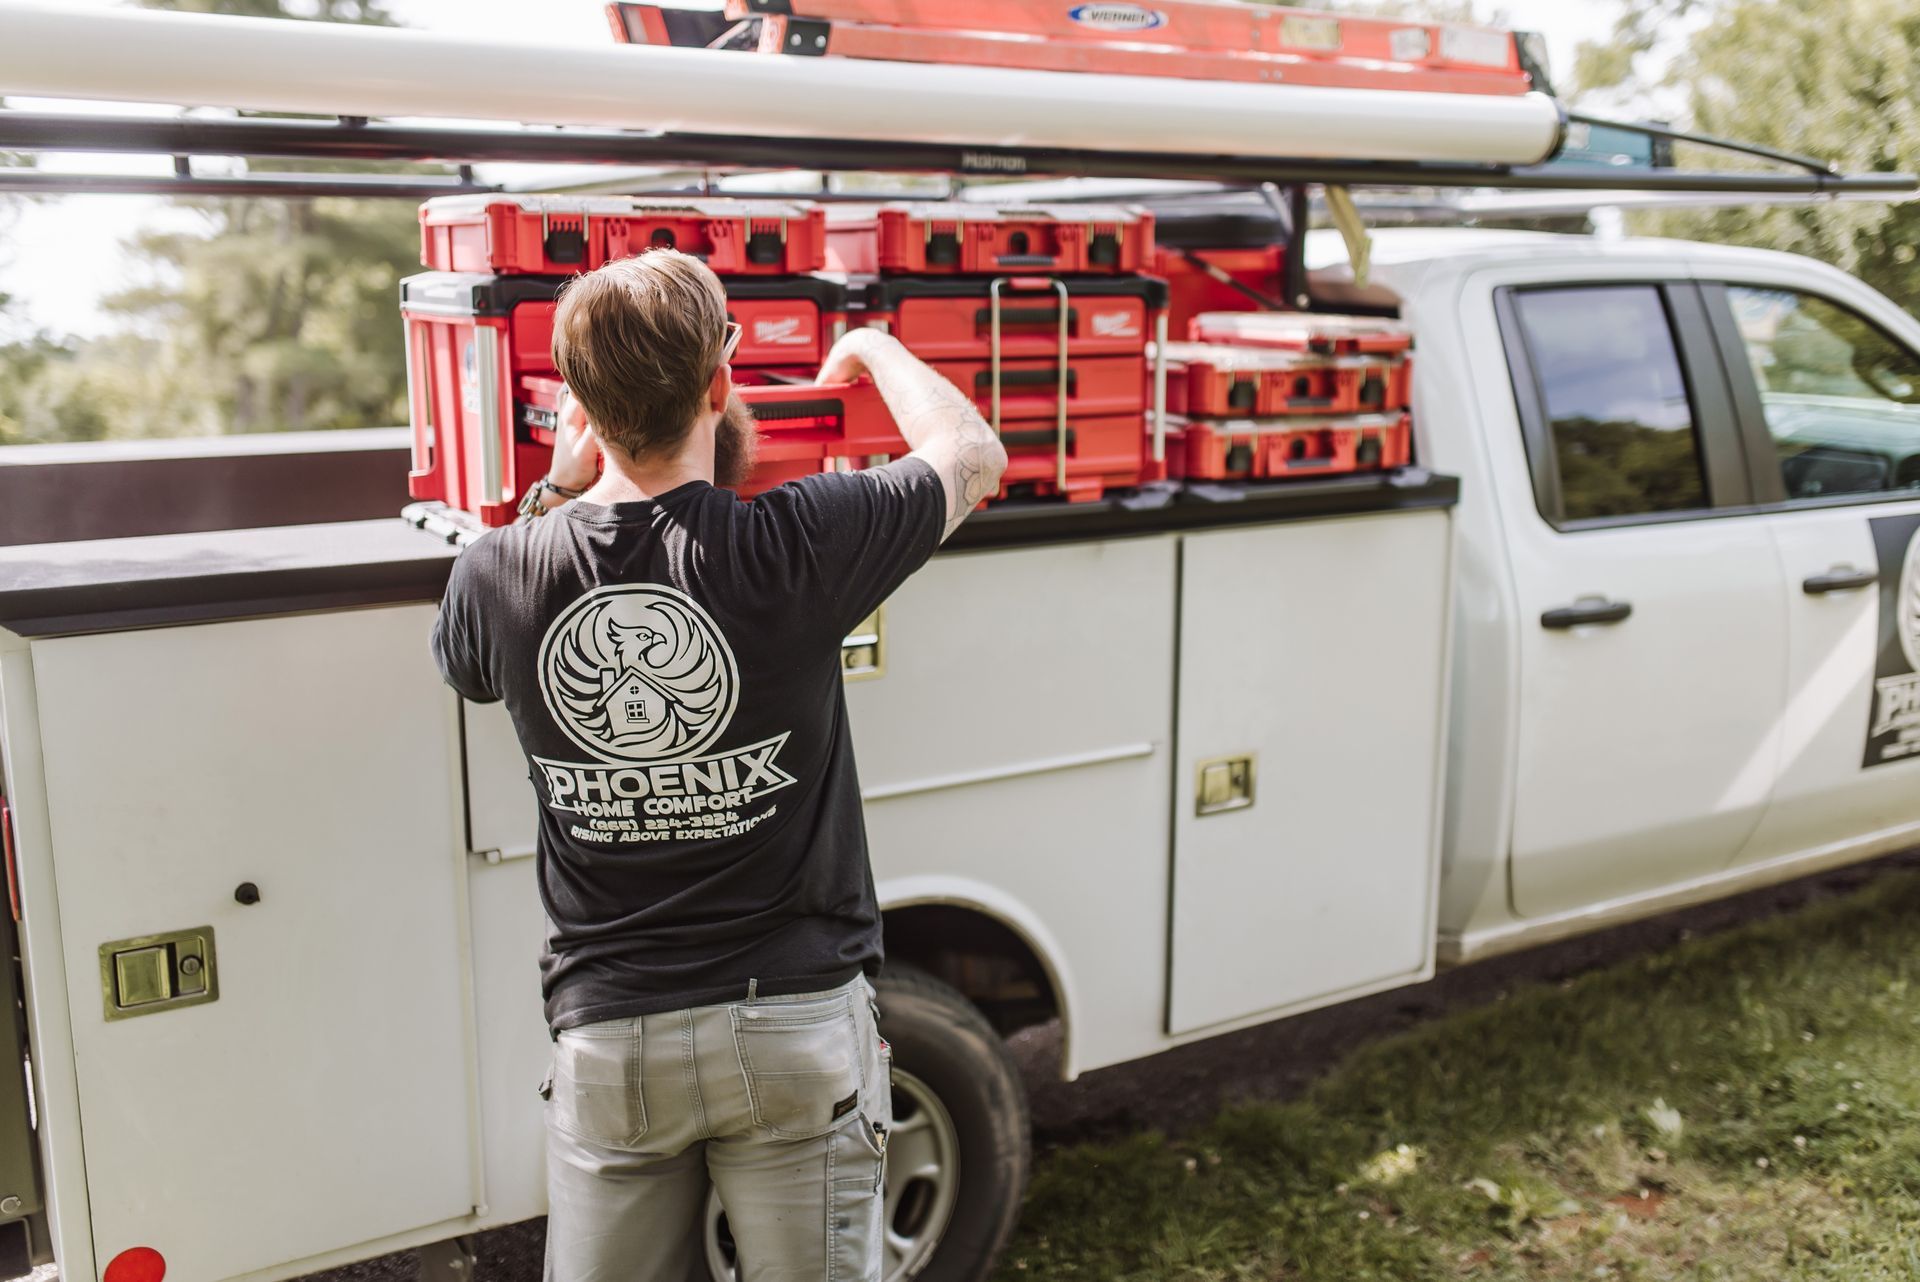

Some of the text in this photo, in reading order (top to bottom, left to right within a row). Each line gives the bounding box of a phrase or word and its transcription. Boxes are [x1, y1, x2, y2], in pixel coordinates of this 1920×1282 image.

[961, 150, 1027, 171] Holman
[546, 745, 782, 805] PHOENIX
[573, 786, 754, 818] HOME COMFORT
[644, 811, 740, 830] 224-3924
[570, 825, 614, 843] RISING
[619, 830, 671, 842] ABOVE
